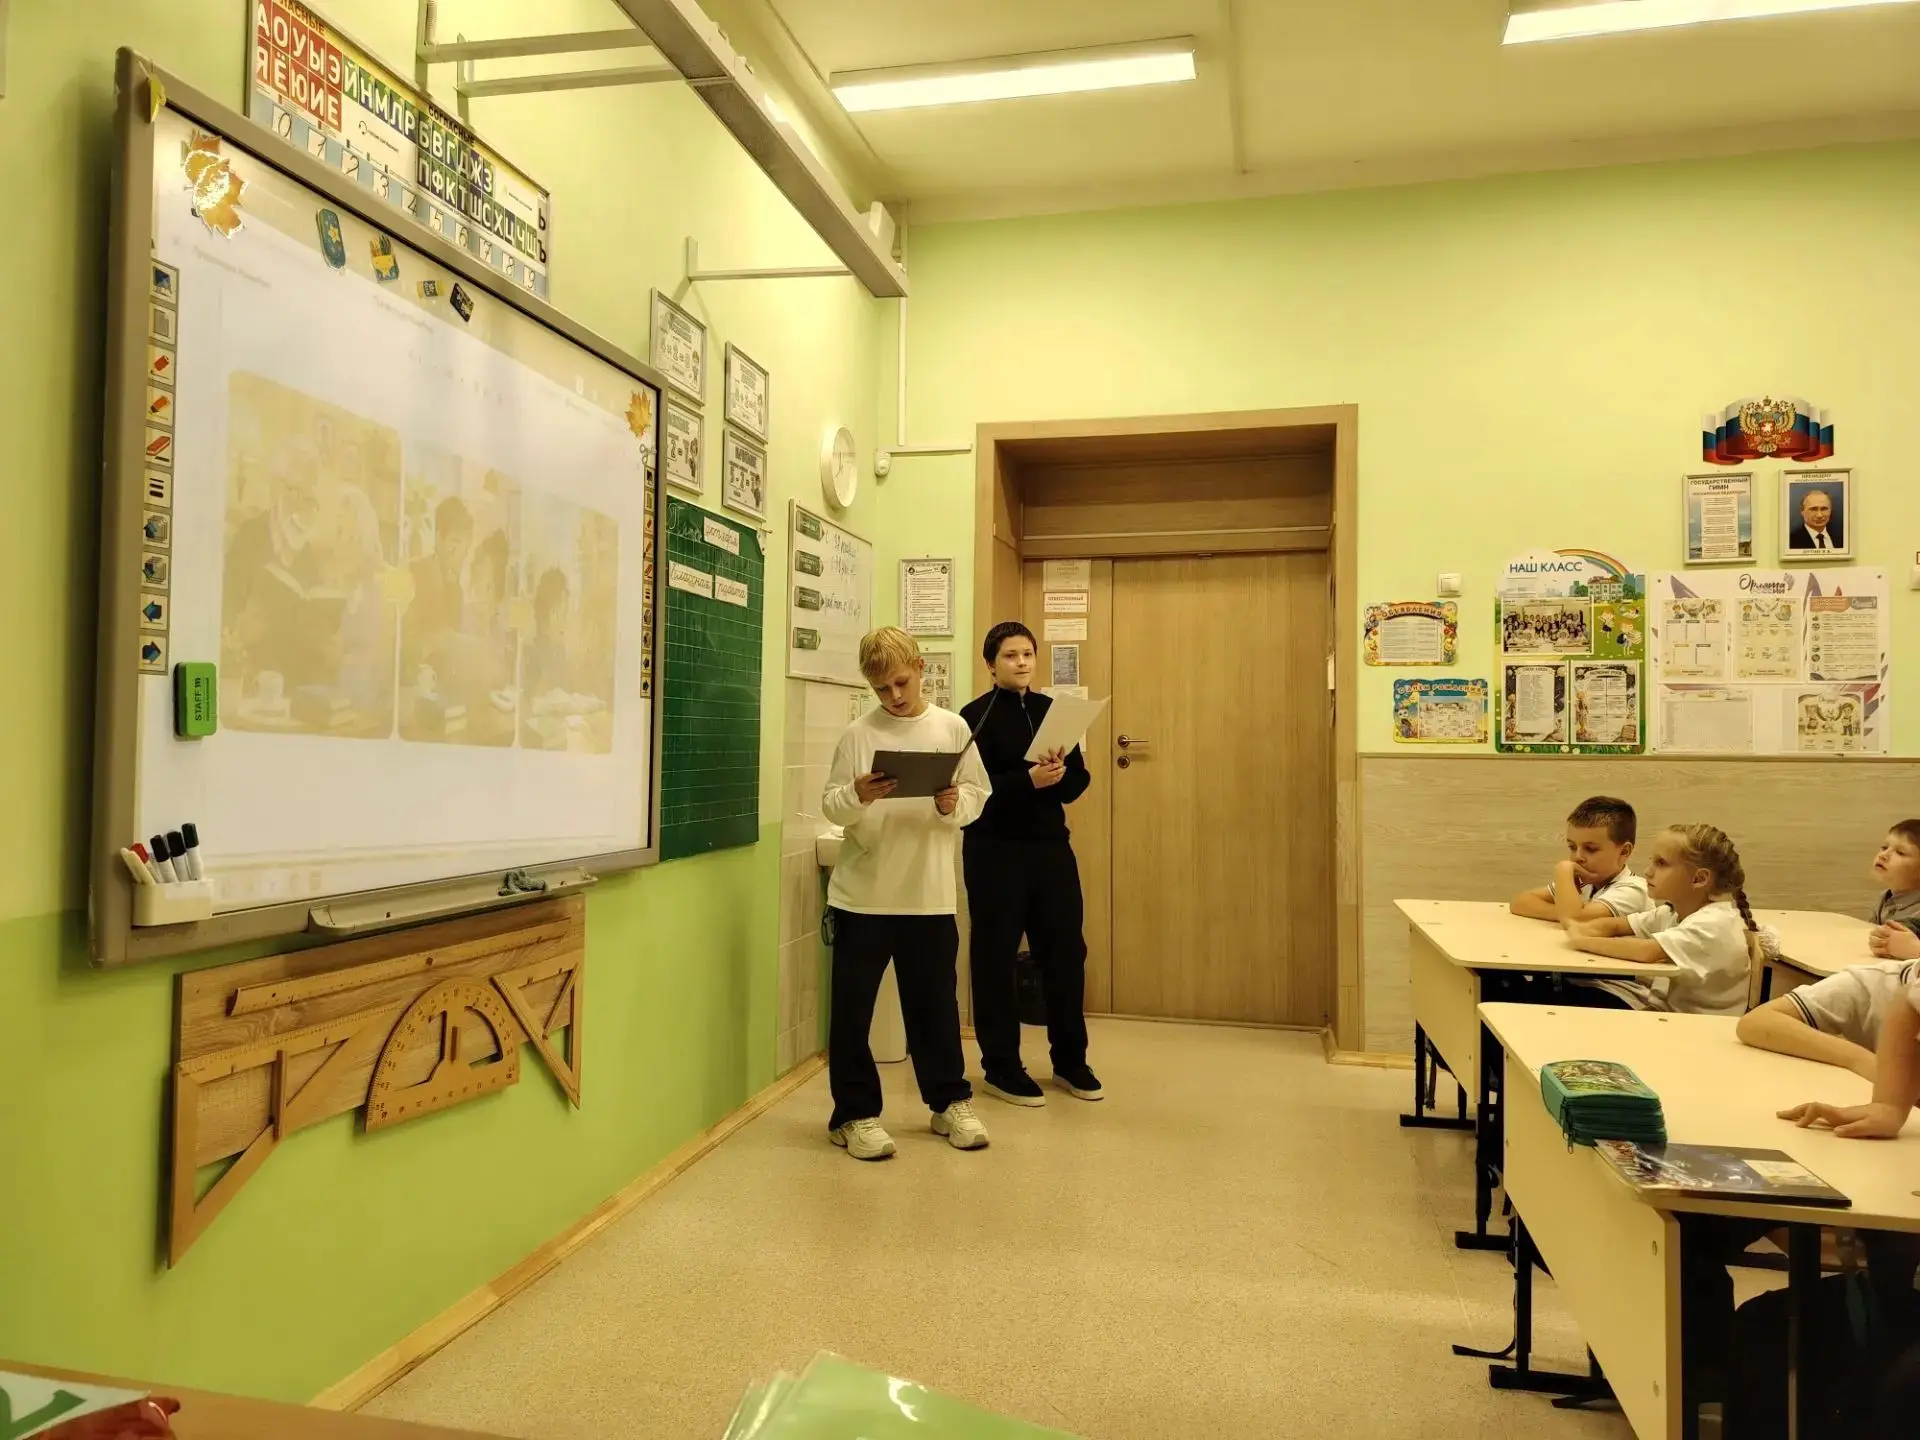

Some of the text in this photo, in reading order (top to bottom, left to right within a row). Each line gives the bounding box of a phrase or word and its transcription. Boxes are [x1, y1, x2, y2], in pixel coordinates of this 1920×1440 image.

[428, 104, 476, 146] СОГЛАСНЫЕ
[1509, 561, 1583, 573] НАШ КЛАСС
